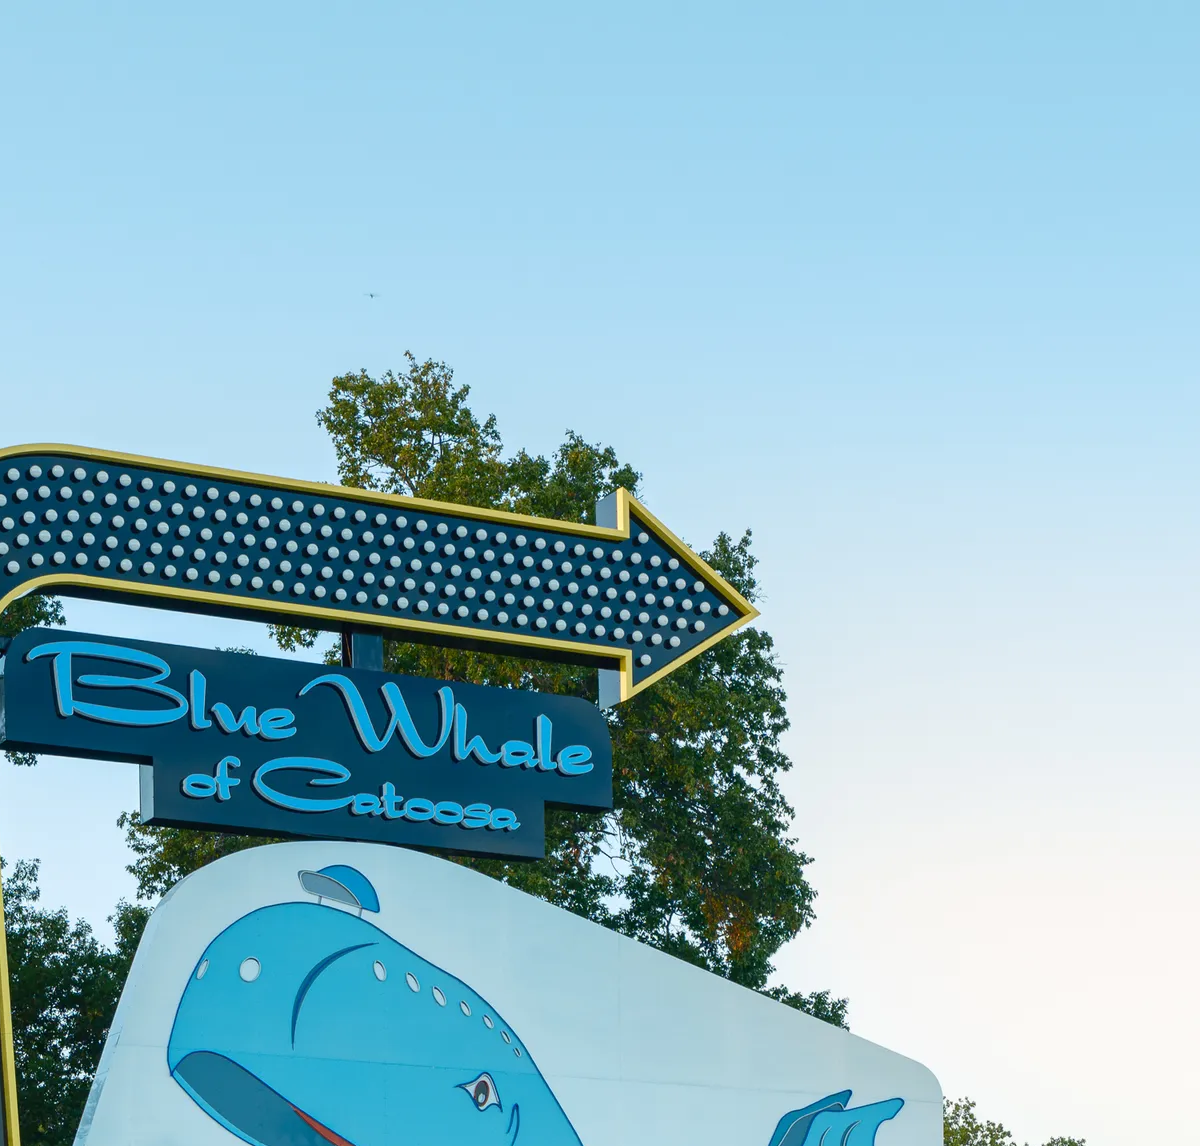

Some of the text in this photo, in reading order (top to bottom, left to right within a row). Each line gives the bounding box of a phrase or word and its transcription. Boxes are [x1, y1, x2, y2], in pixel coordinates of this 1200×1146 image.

[26, 640, 595, 776] Blue Whale
[181, 755, 521, 831] of Catoosa
